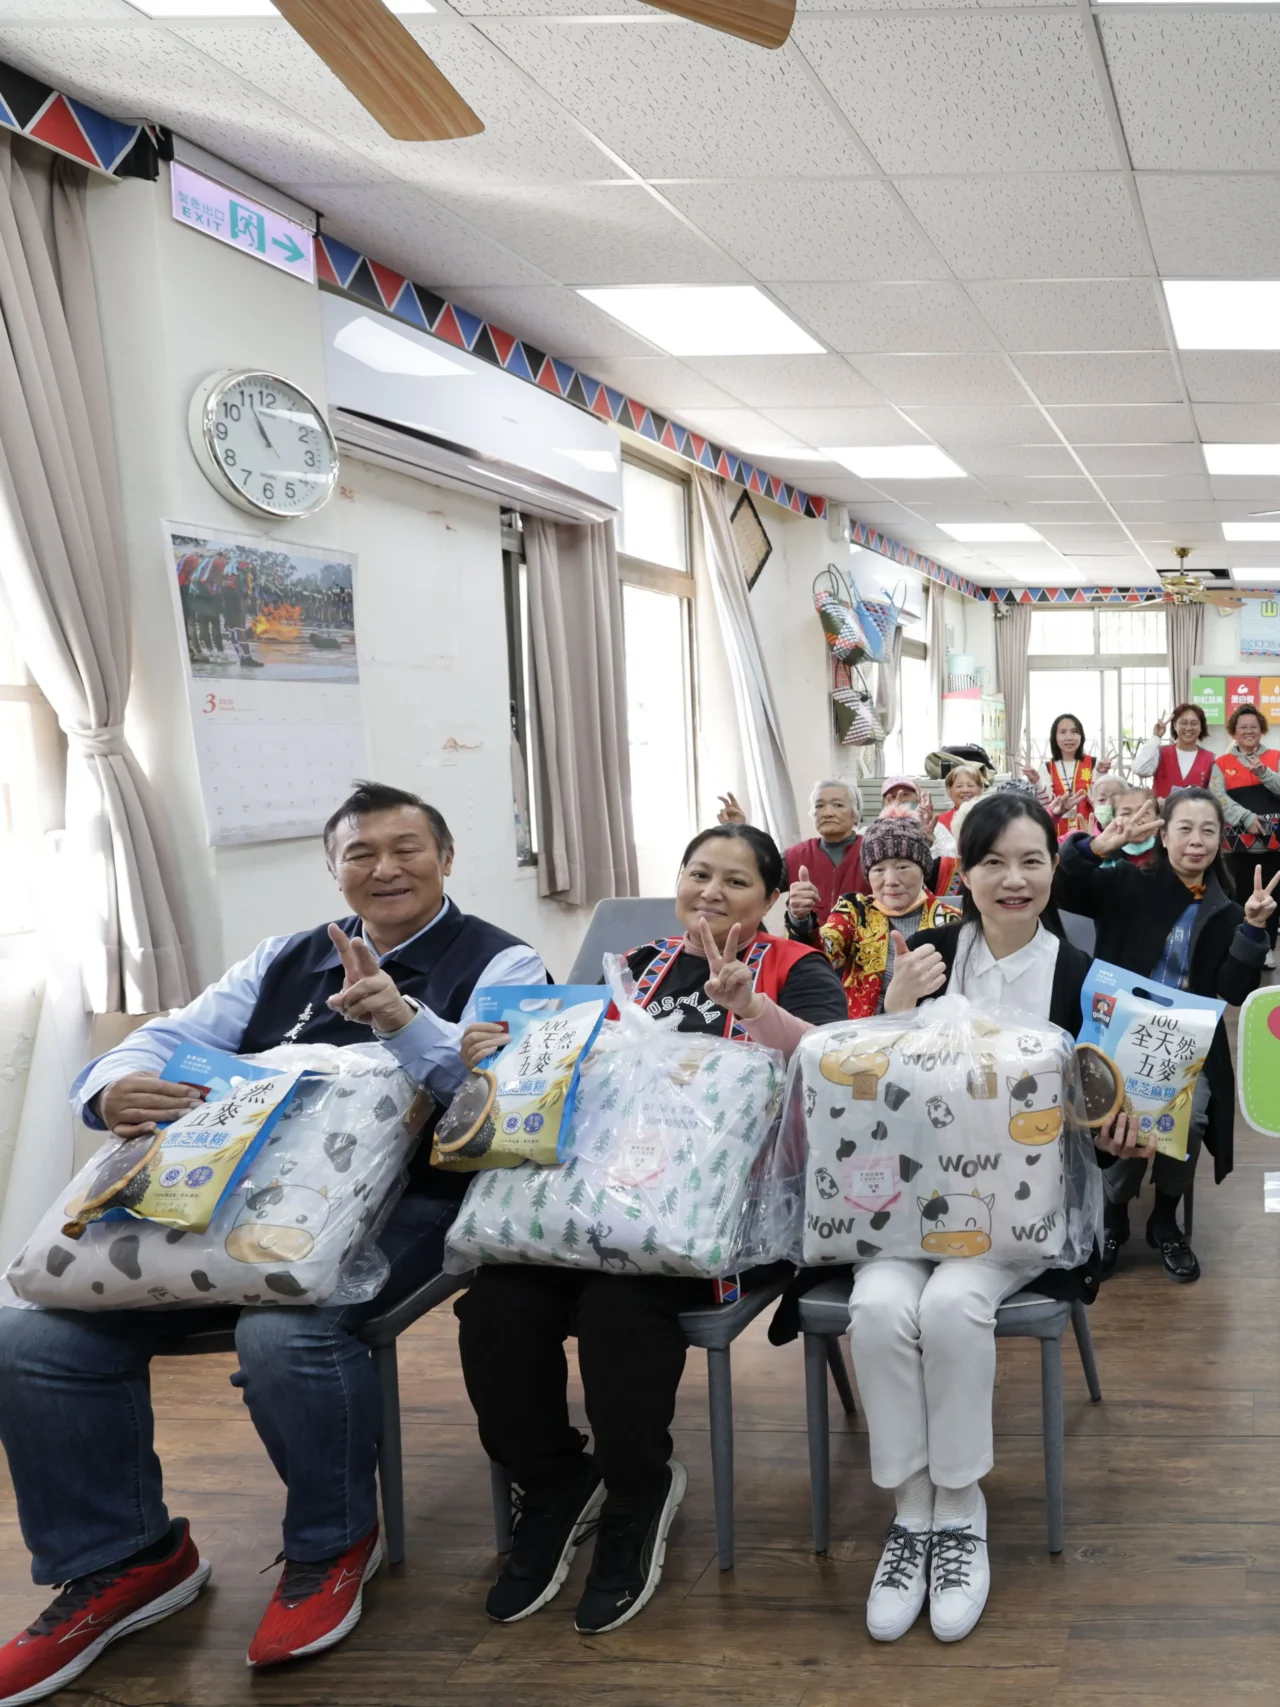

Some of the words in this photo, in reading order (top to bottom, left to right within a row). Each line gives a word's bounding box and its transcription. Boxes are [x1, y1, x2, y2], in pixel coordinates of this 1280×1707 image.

[178, 190, 225, 222] 緊急出口
[182, 206, 223, 233] EXIT
[258, 390, 276, 408] 12
[223, 401, 241, 422] 10
[215, 422, 228, 440] 9
[298, 426, 310, 443] 2
[224, 448, 237, 467] 8
[304, 450, 316, 467] 3
[240, 468, 252, 486] 7
[263, 482, 275, 500] 6
[284, 482, 296, 498] 5
[203, 693, 217, 714] 3
[539, 1020, 568, 1032] 100
[1150, 1014, 1179, 1030] 100
[1130, 1024, 1197, 1061] 全天然
[518, 1051, 553, 1077] 五麥
[1134, 1052, 1178, 1082] 五麥
[497, 1079, 547, 1095] 麻糊
[1126, 1076, 1177, 1100] 黑芝麻糊
[164, 1130, 230, 1147] 黑芝麻糊
[939, 1153, 1002, 1178] WOW
